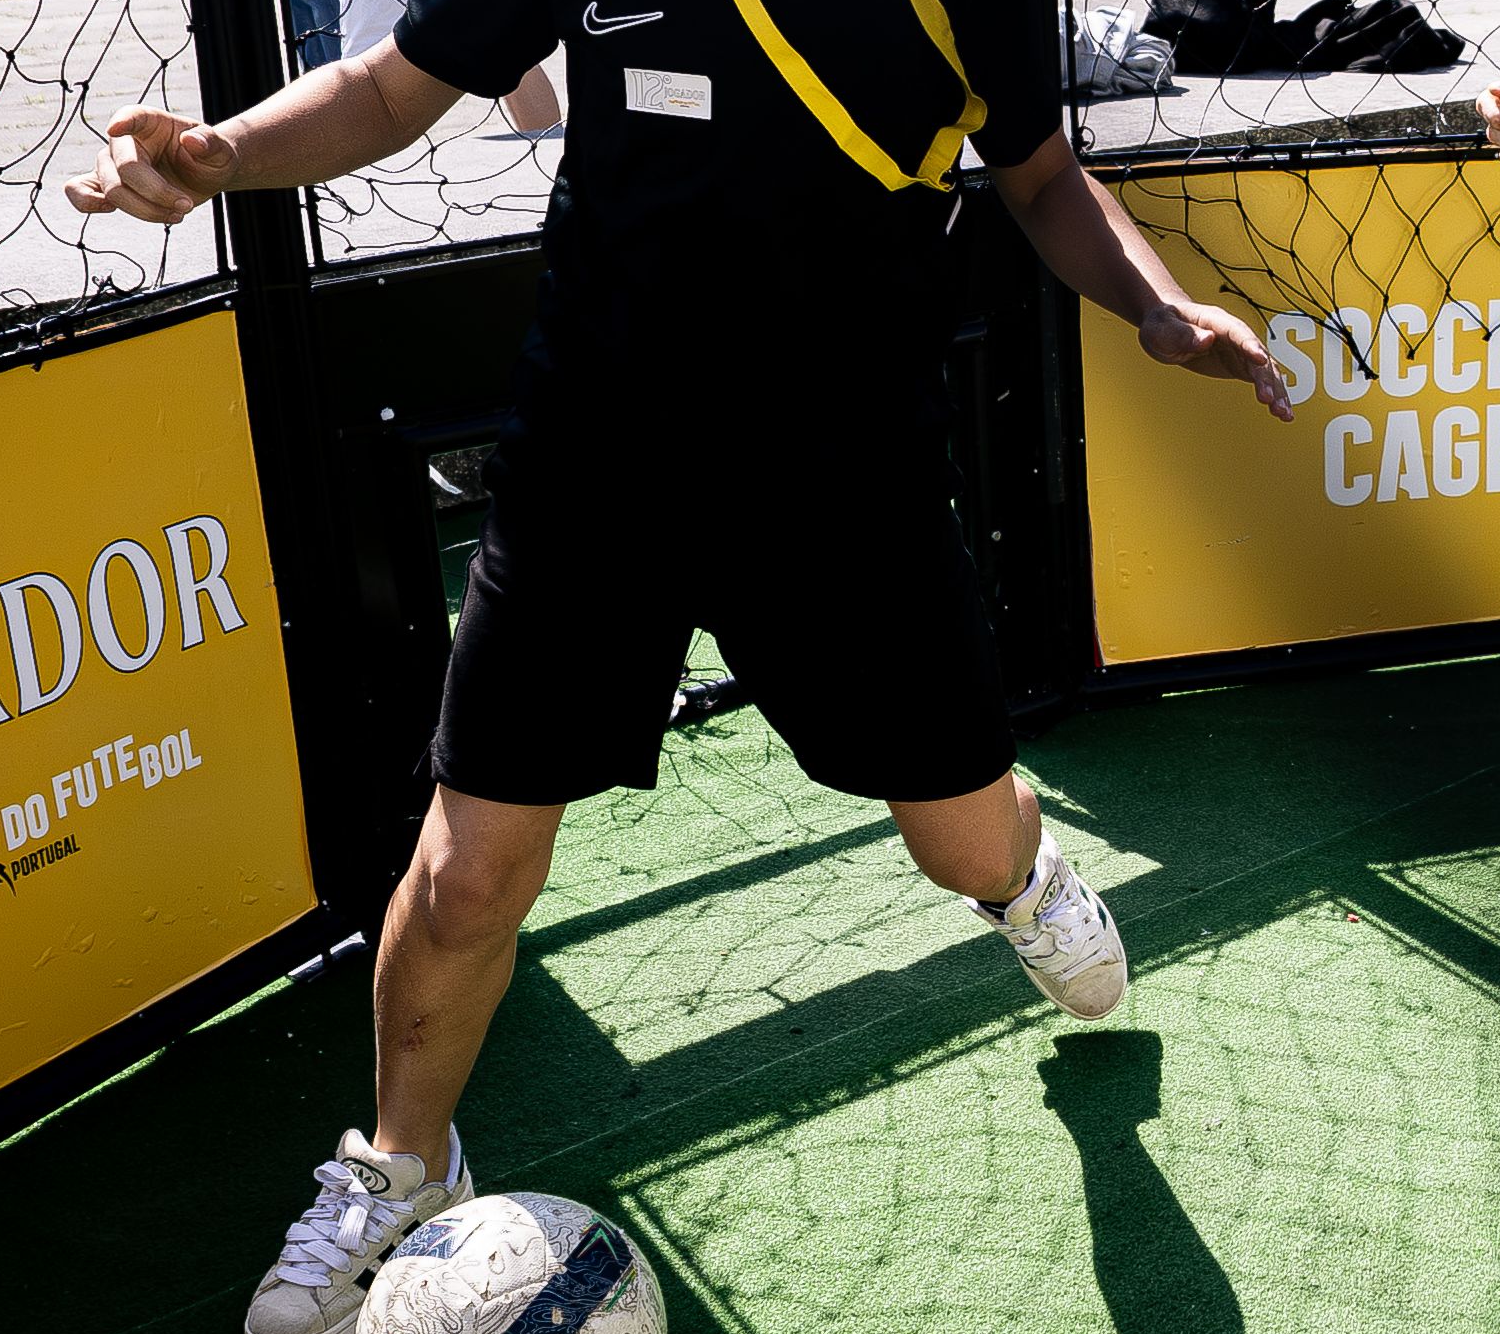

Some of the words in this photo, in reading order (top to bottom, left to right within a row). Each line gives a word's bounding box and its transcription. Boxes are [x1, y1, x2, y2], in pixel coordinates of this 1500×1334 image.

[0, 793, 50, 852] DO
[51, 728, 203, 819] FUTEBOL
[10, 833, 82, 882] PORTUGAL
